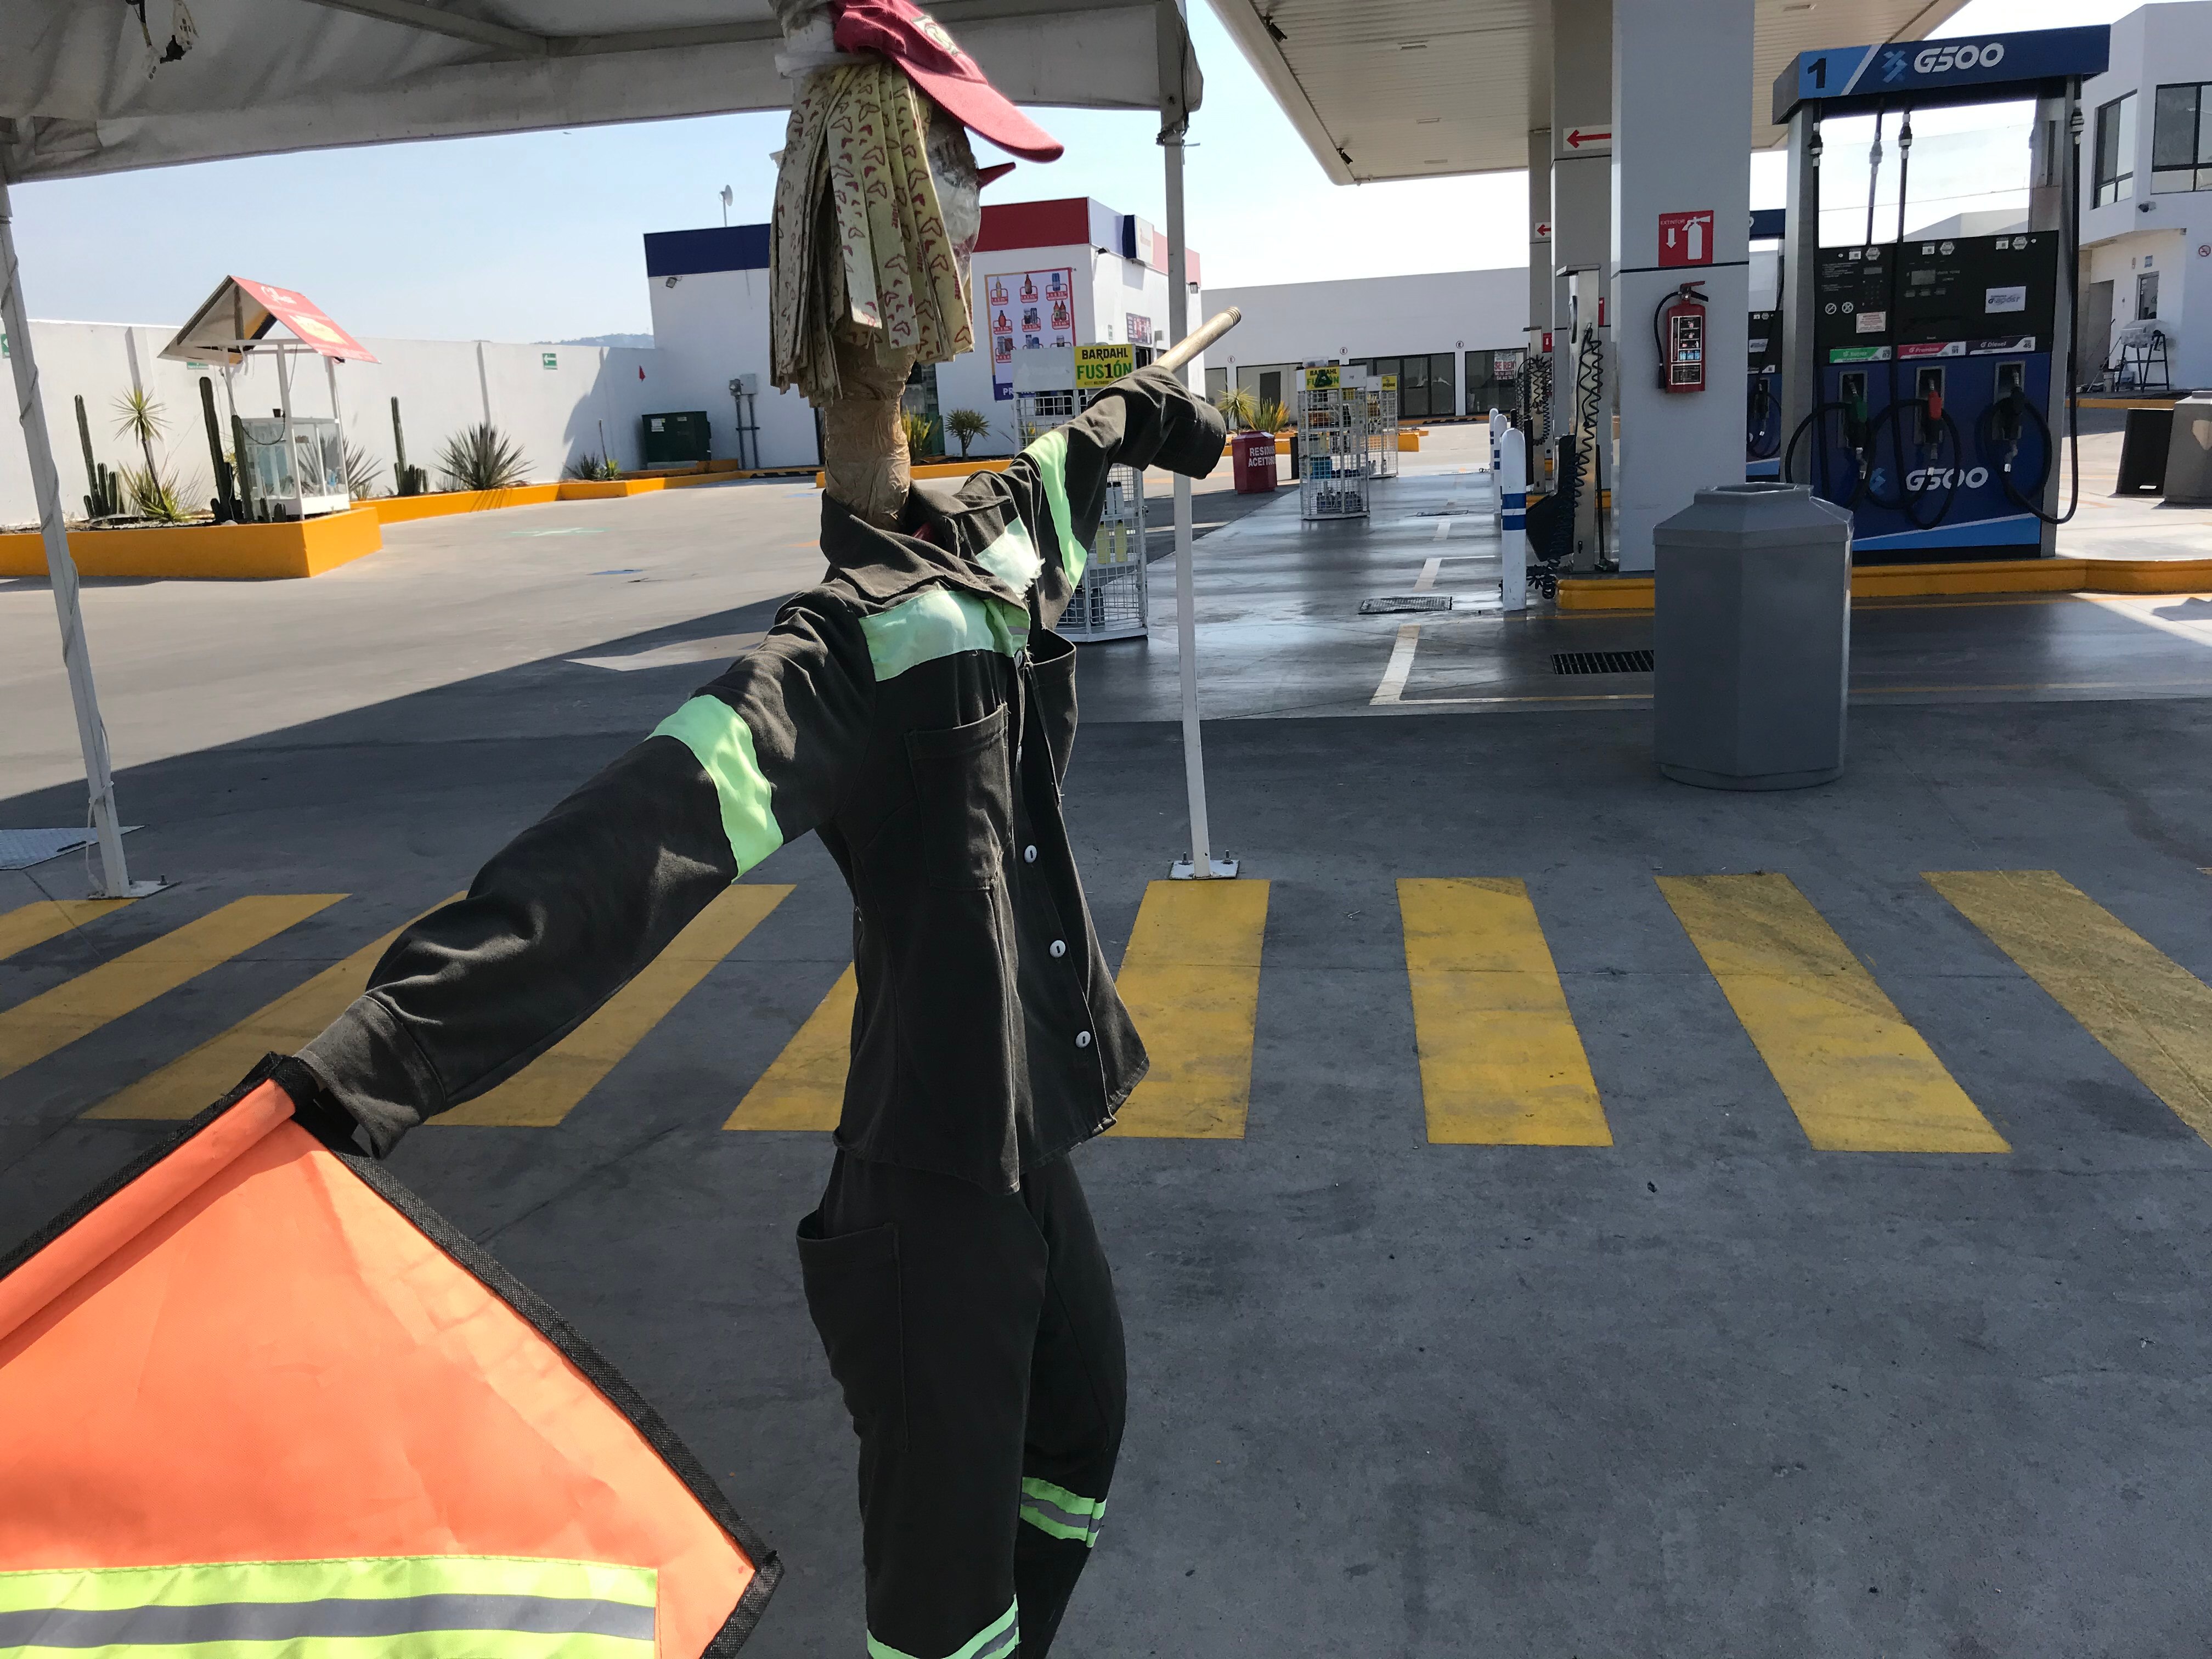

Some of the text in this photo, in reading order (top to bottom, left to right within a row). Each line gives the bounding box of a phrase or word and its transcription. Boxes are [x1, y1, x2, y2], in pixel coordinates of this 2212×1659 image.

[1914, 42, 2005, 74] G500
[1807, 57, 1827, 89] 1
[1082, 347, 1128, 362] BARDAHL
[1494, 360, 1516, 370] SE REN
[1906, 467, 1989, 491] G500
